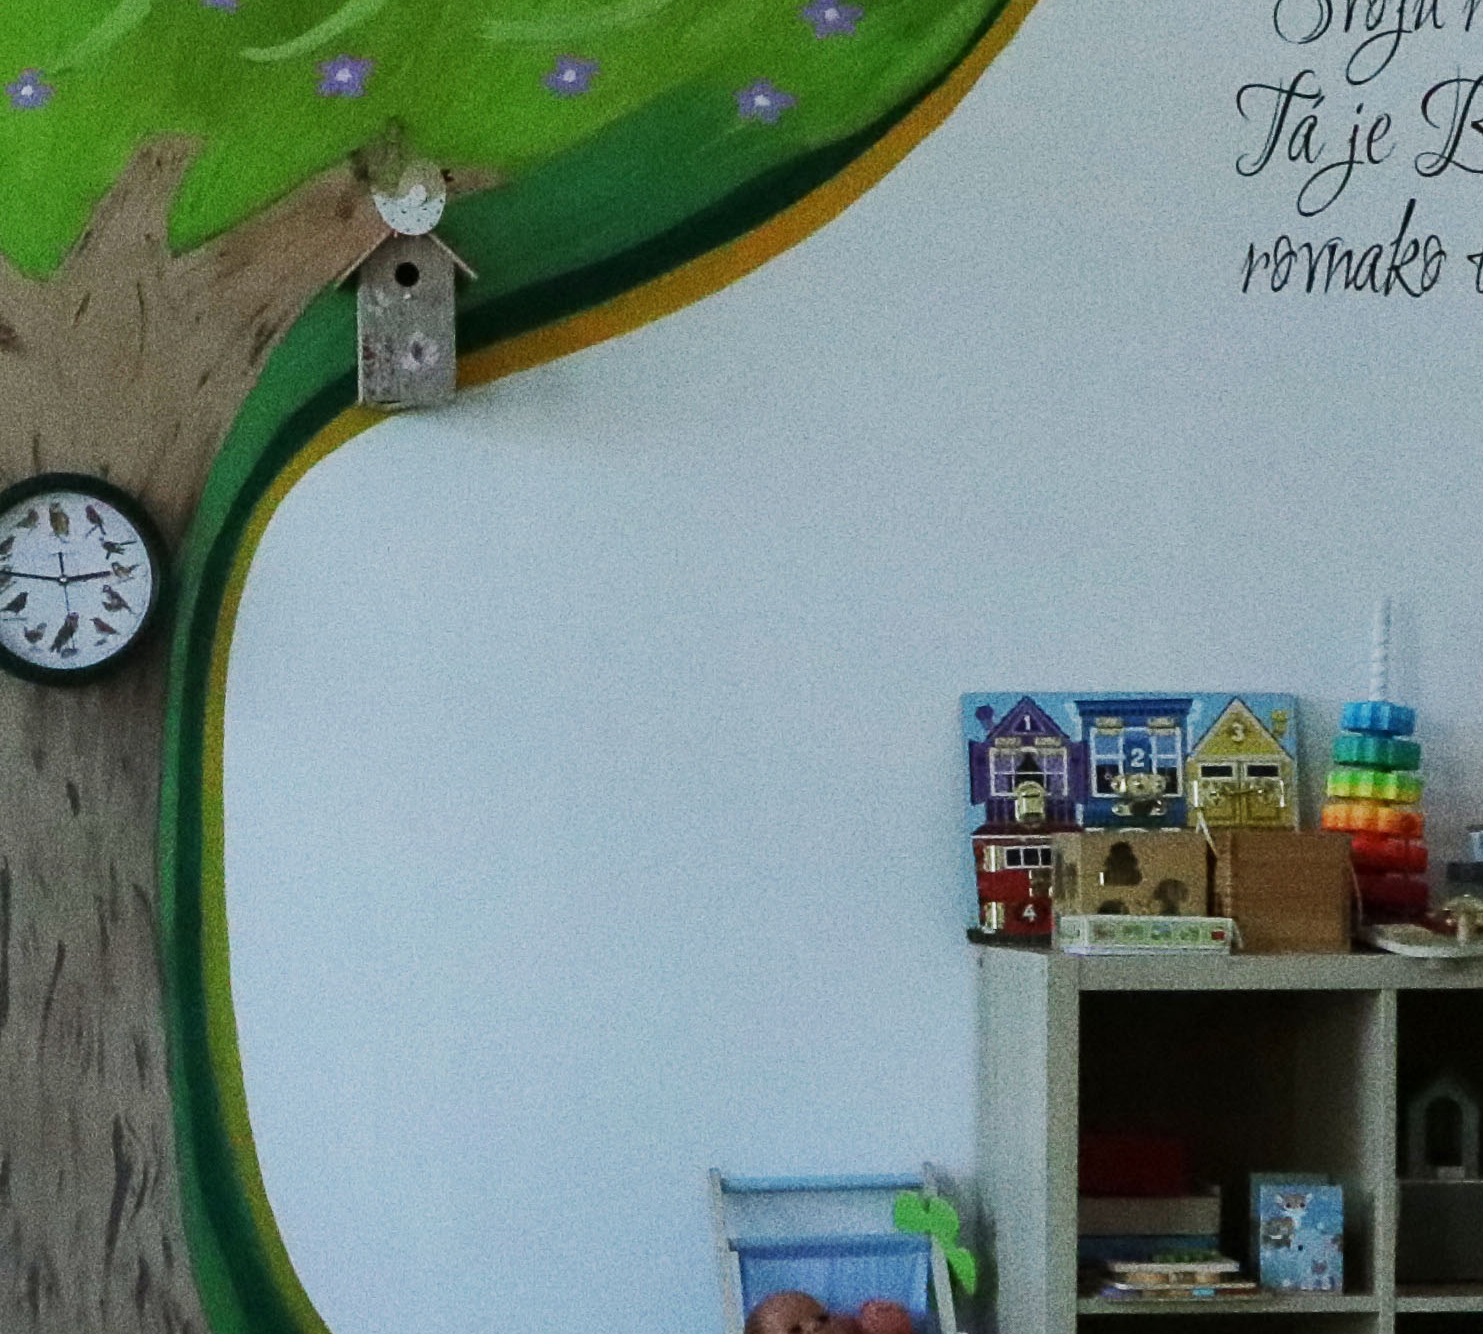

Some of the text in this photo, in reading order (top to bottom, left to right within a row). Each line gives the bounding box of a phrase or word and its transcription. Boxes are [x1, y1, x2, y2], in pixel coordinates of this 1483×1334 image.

[1235, 69, 1326, 178] Tá
[1296, 103, 1396, 218] je
[1241, 197, 1448, 299] rovnako
[1023, 715, 1031, 731] 1
[1232, 724, 1244, 742] 3
[1131, 748, 1145, 767] 2
[1022, 905, 1037, 922] 4
